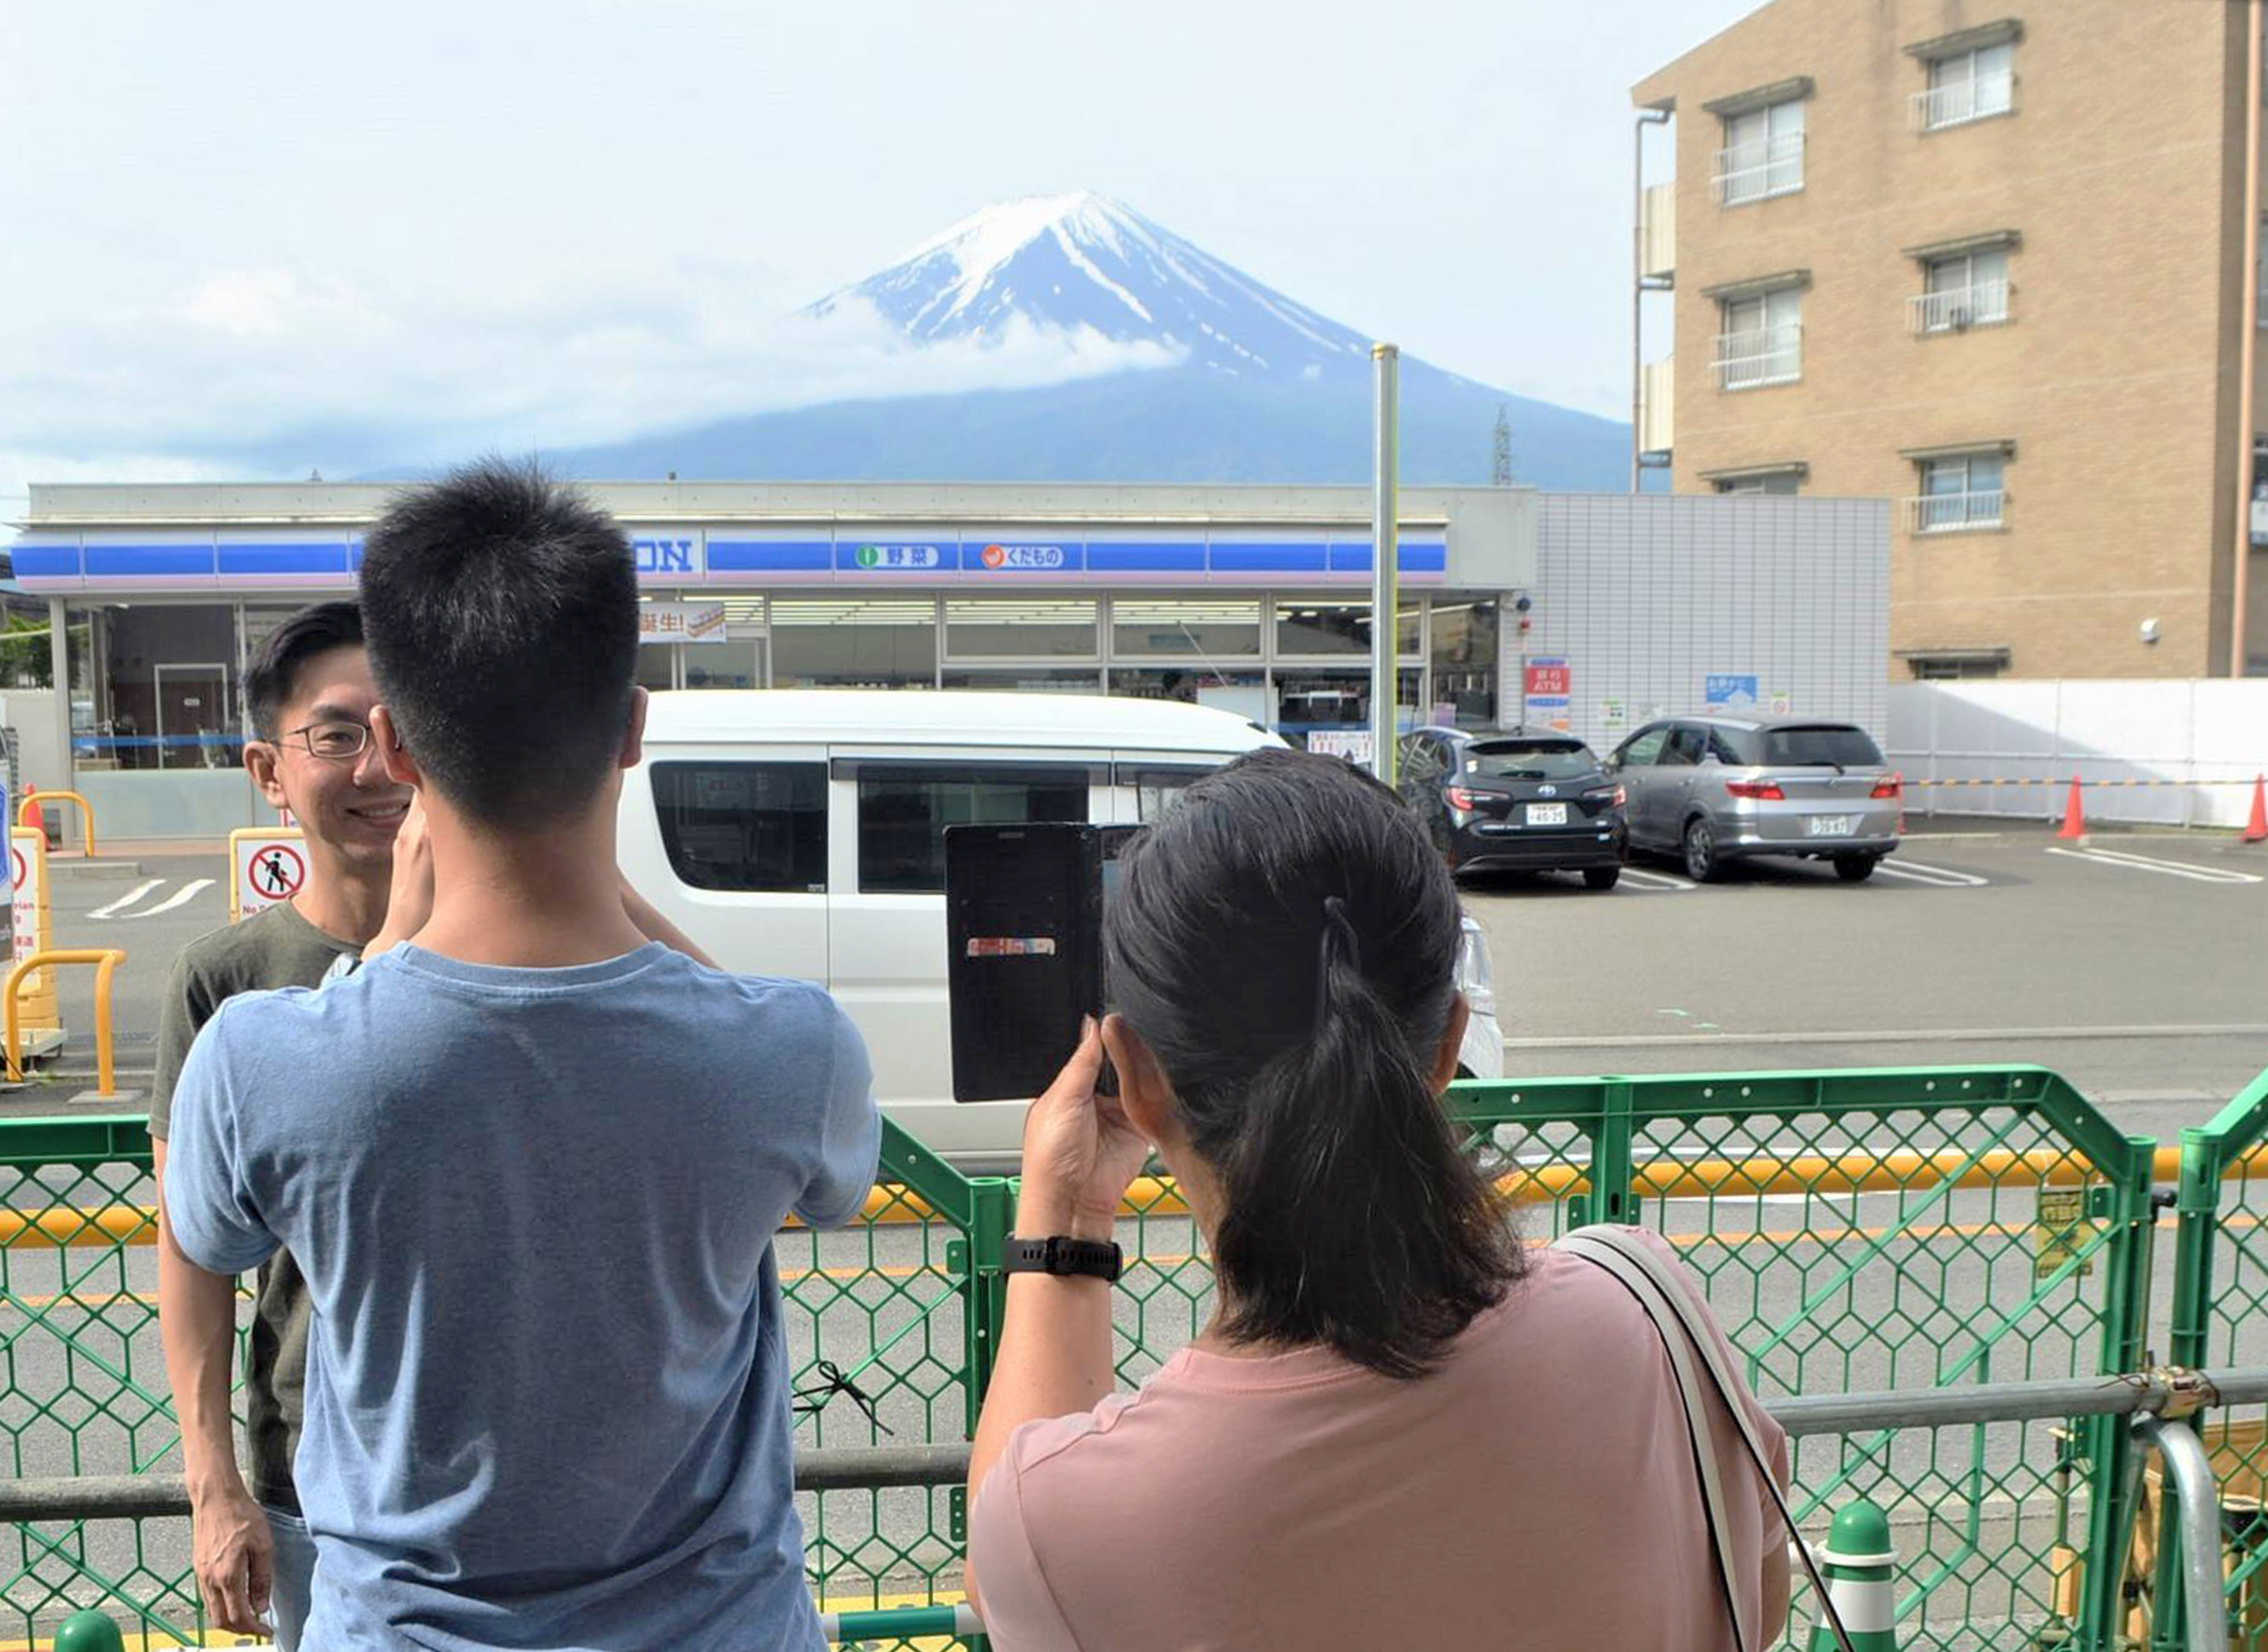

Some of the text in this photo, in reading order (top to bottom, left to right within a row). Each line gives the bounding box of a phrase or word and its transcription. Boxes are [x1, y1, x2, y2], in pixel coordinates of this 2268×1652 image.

[886, 548, 928, 565] 野菜
[1007, 548, 1060, 565] くだもの
[1533, 681, 1563, 692] ATM
[242, 905, 257, 914] No
